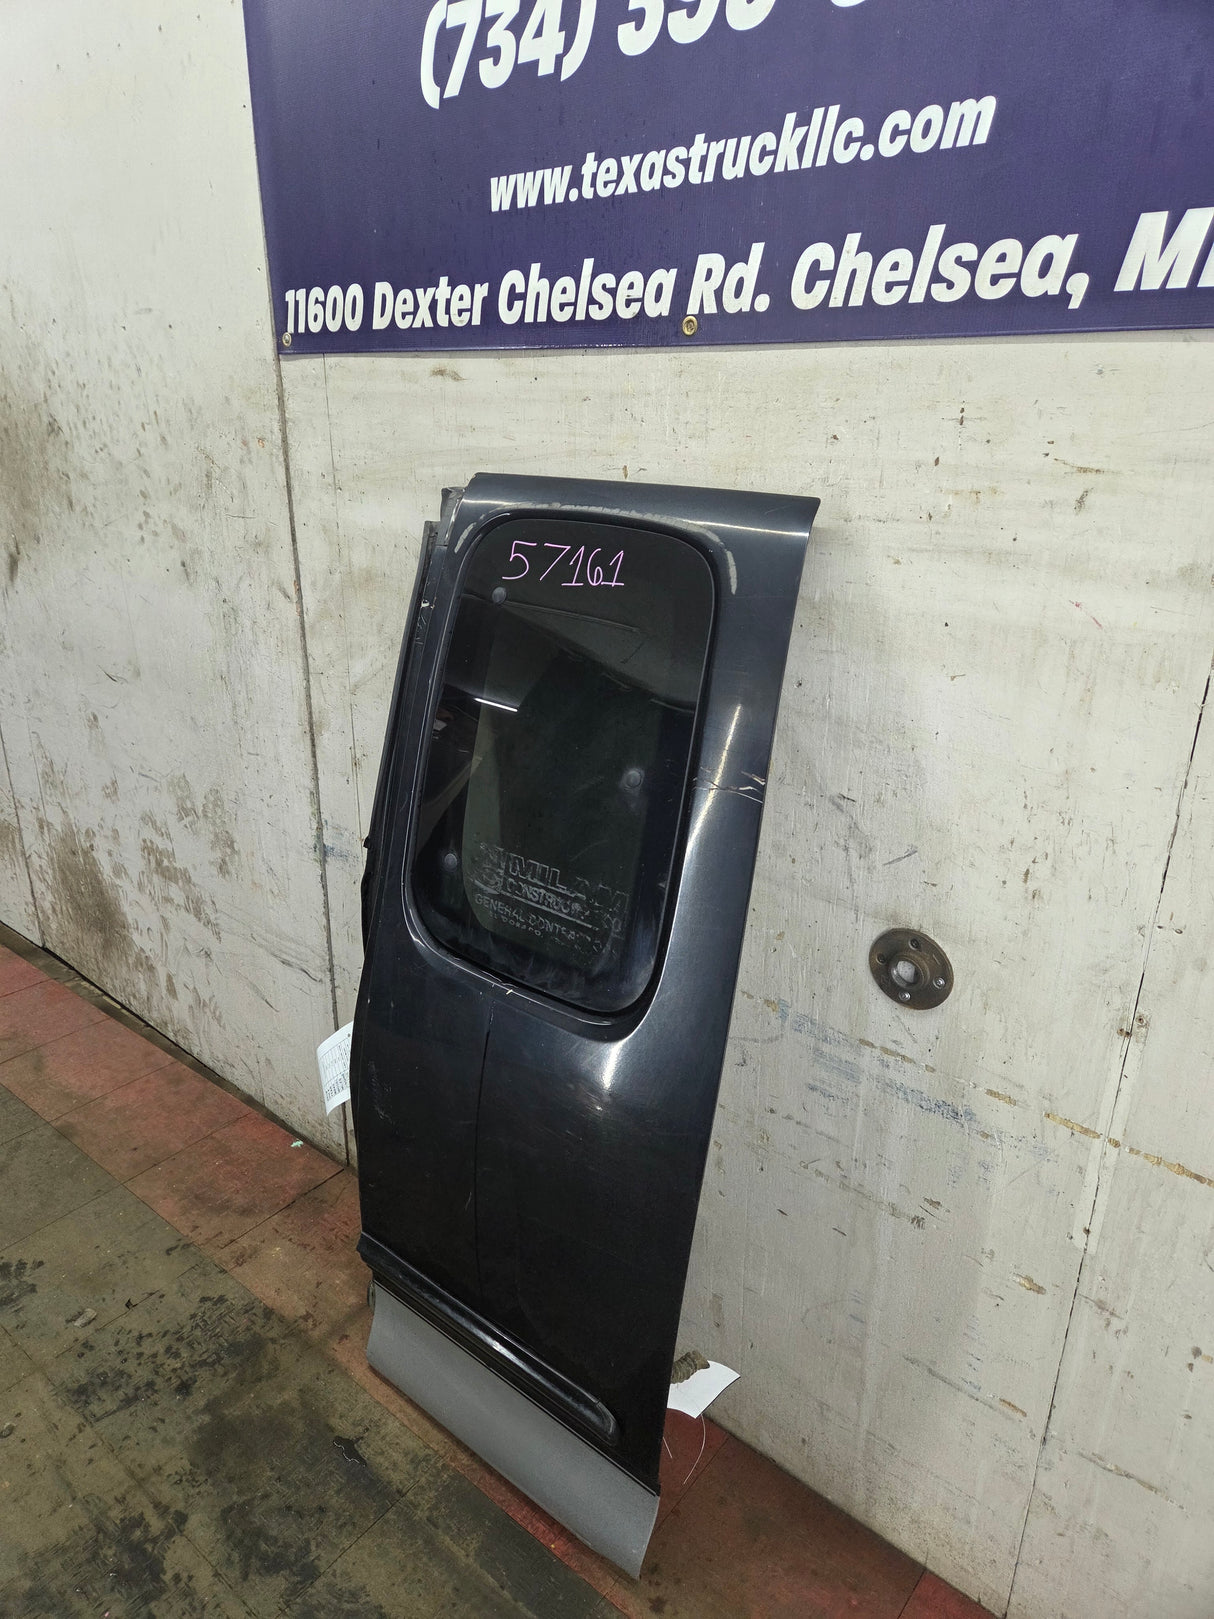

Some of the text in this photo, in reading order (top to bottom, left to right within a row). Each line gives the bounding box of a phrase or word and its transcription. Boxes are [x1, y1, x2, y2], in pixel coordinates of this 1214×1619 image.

[421, 0, 597, 109] (734)
[491, 95, 997, 212] www.texastruckllc.com
[284, 206, 1214, 334] 11600 Dexter Chelsea Rd. Chelsea, M
[502, 540, 625, 587] 57161
